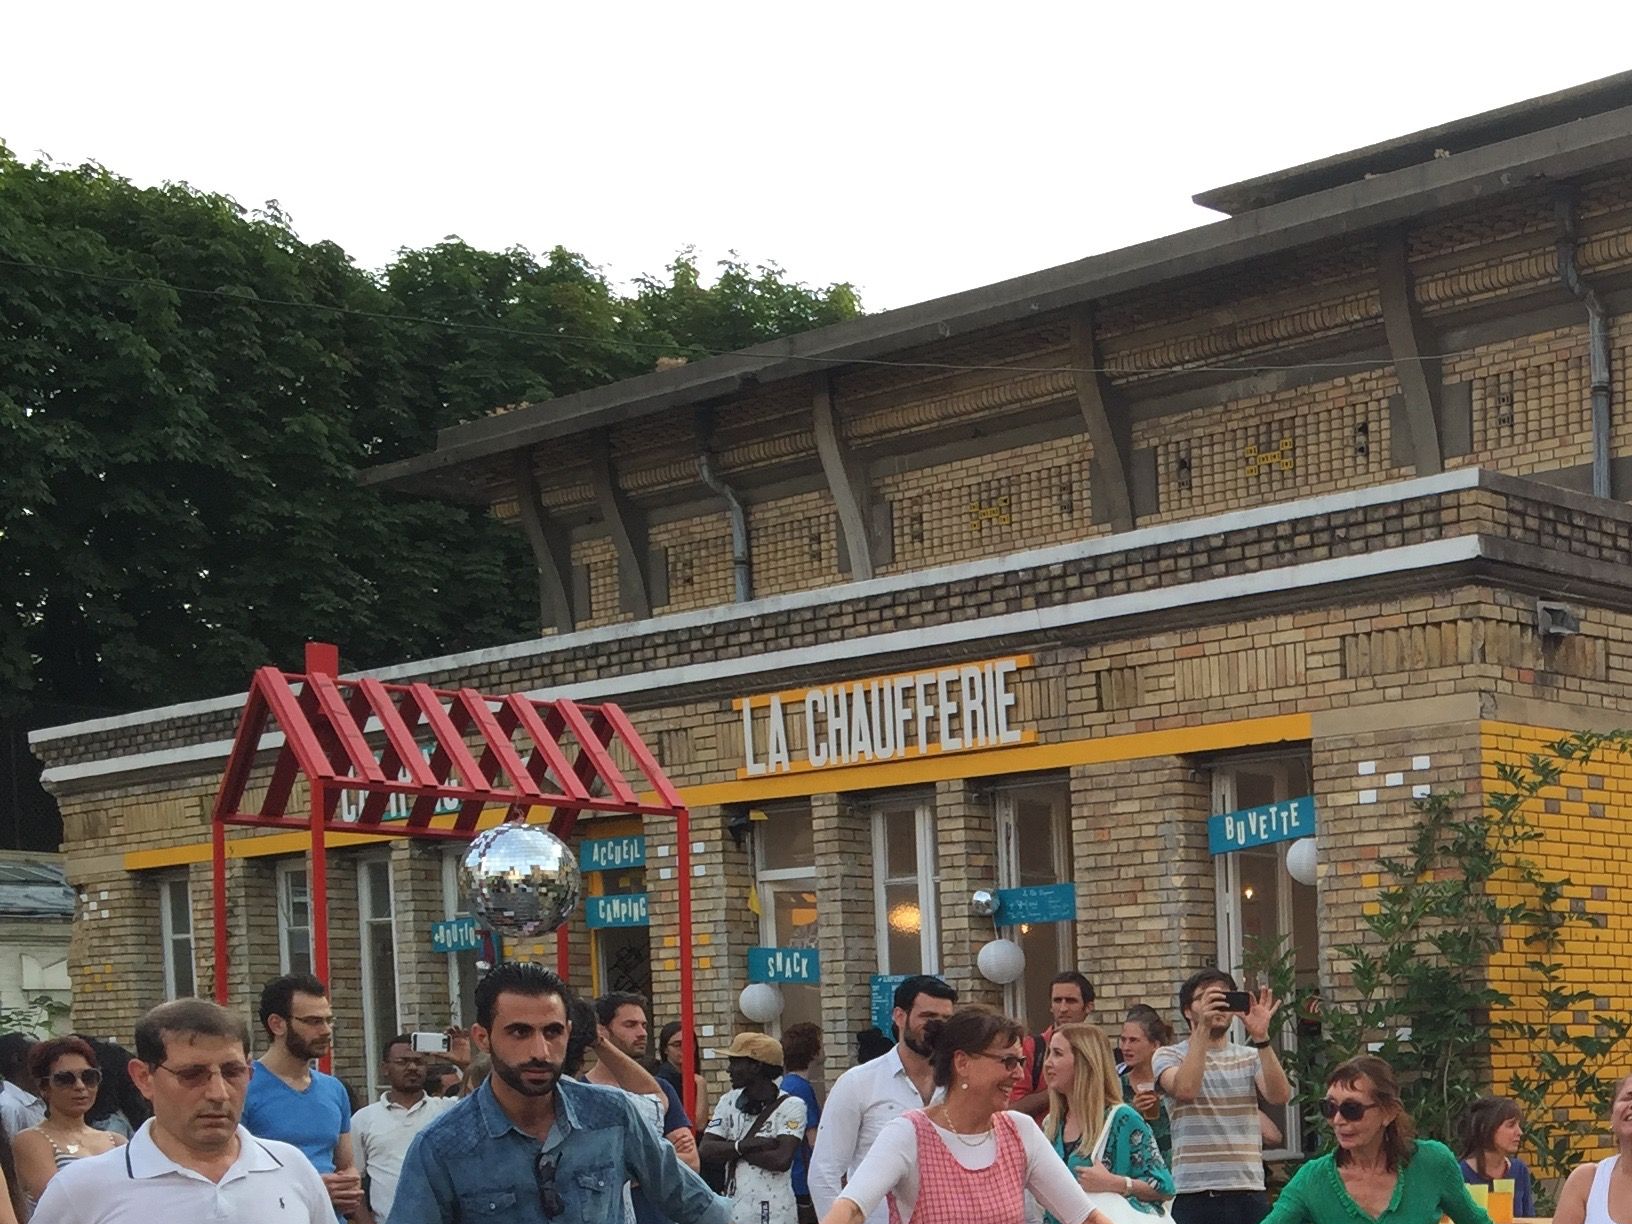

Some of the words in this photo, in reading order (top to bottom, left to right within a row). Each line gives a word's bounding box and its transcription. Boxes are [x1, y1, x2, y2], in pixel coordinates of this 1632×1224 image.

[742, 696, 791, 776] LA
[805, 659, 1022, 768] CHAUFFERIE
[1225, 802, 1300, 845] BUVETTE
[592, 839, 641, 866] ACCUEIL
[598, 897, 647, 923] CAMPING
[767, 951, 809, 978] SNACK
